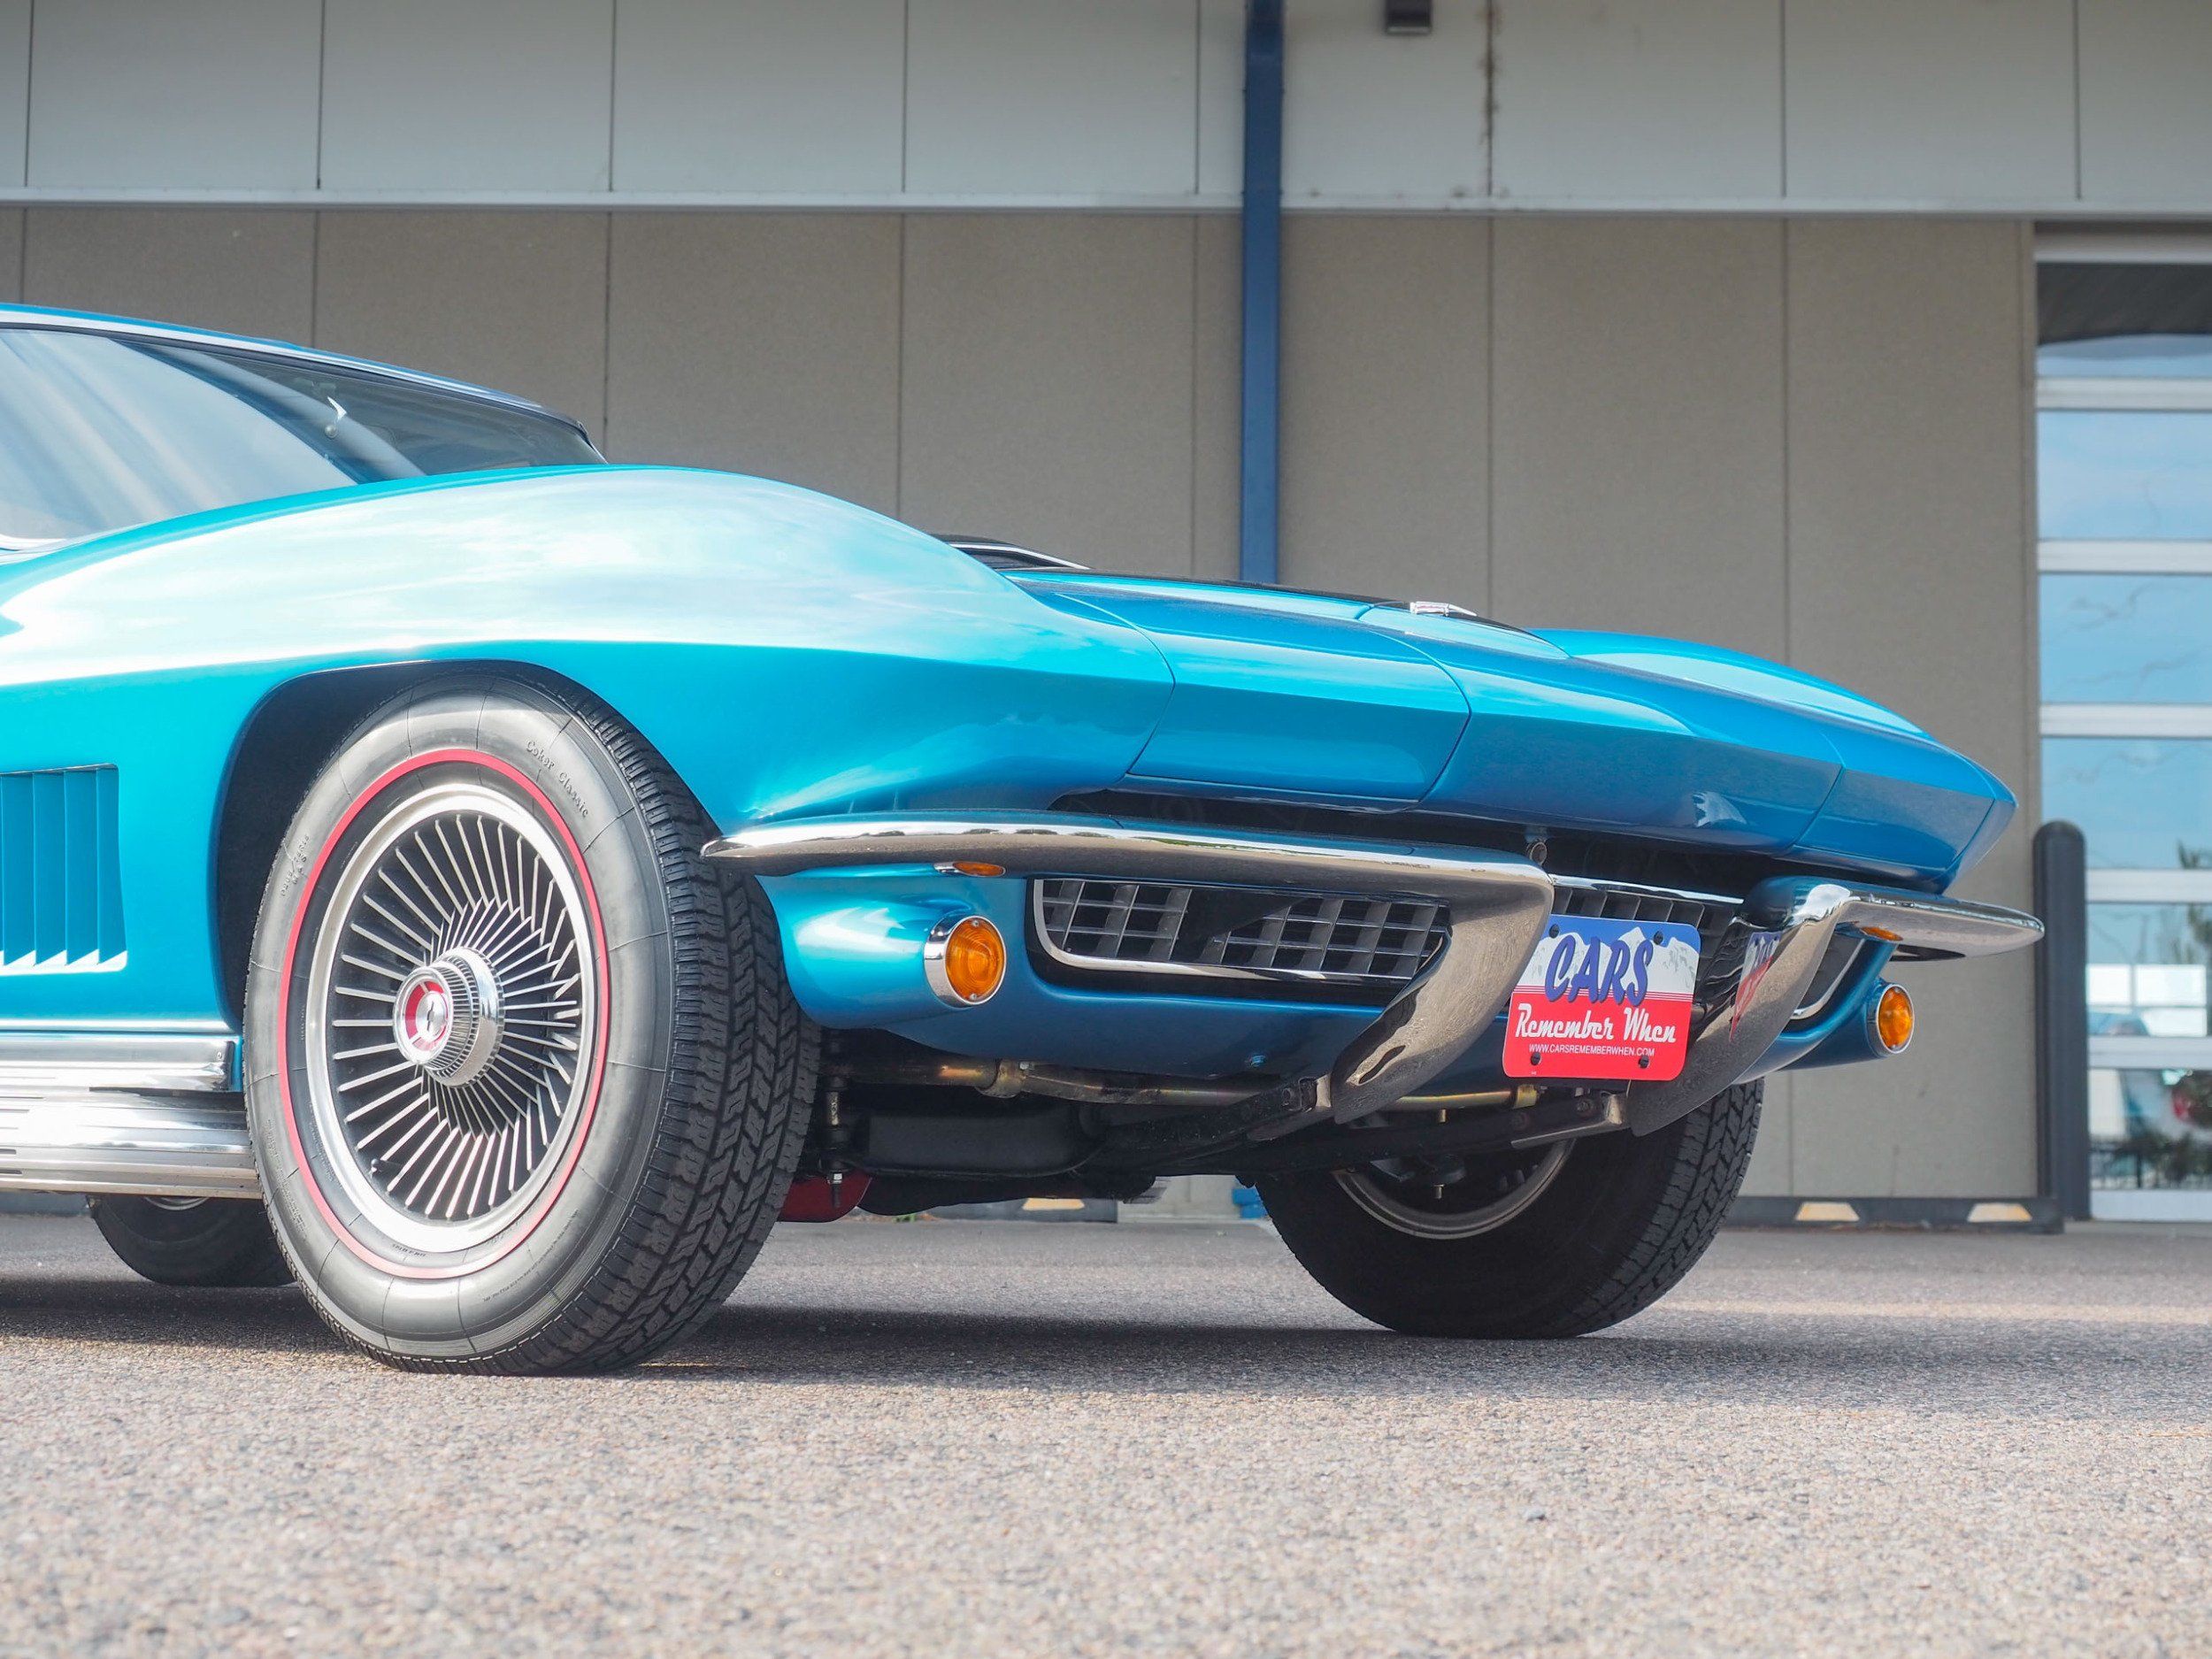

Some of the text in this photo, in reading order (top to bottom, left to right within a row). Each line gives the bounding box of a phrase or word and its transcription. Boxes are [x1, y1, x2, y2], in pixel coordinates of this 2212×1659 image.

[526, 741, 588, 818] Coker Classic
[1545, 935, 1653, 1006] CARS
[1515, 1002, 1677, 1043] Remember When
[1529, 1043, 1655, 1056] WWW.CARSREMEMBERWHEN.COM
